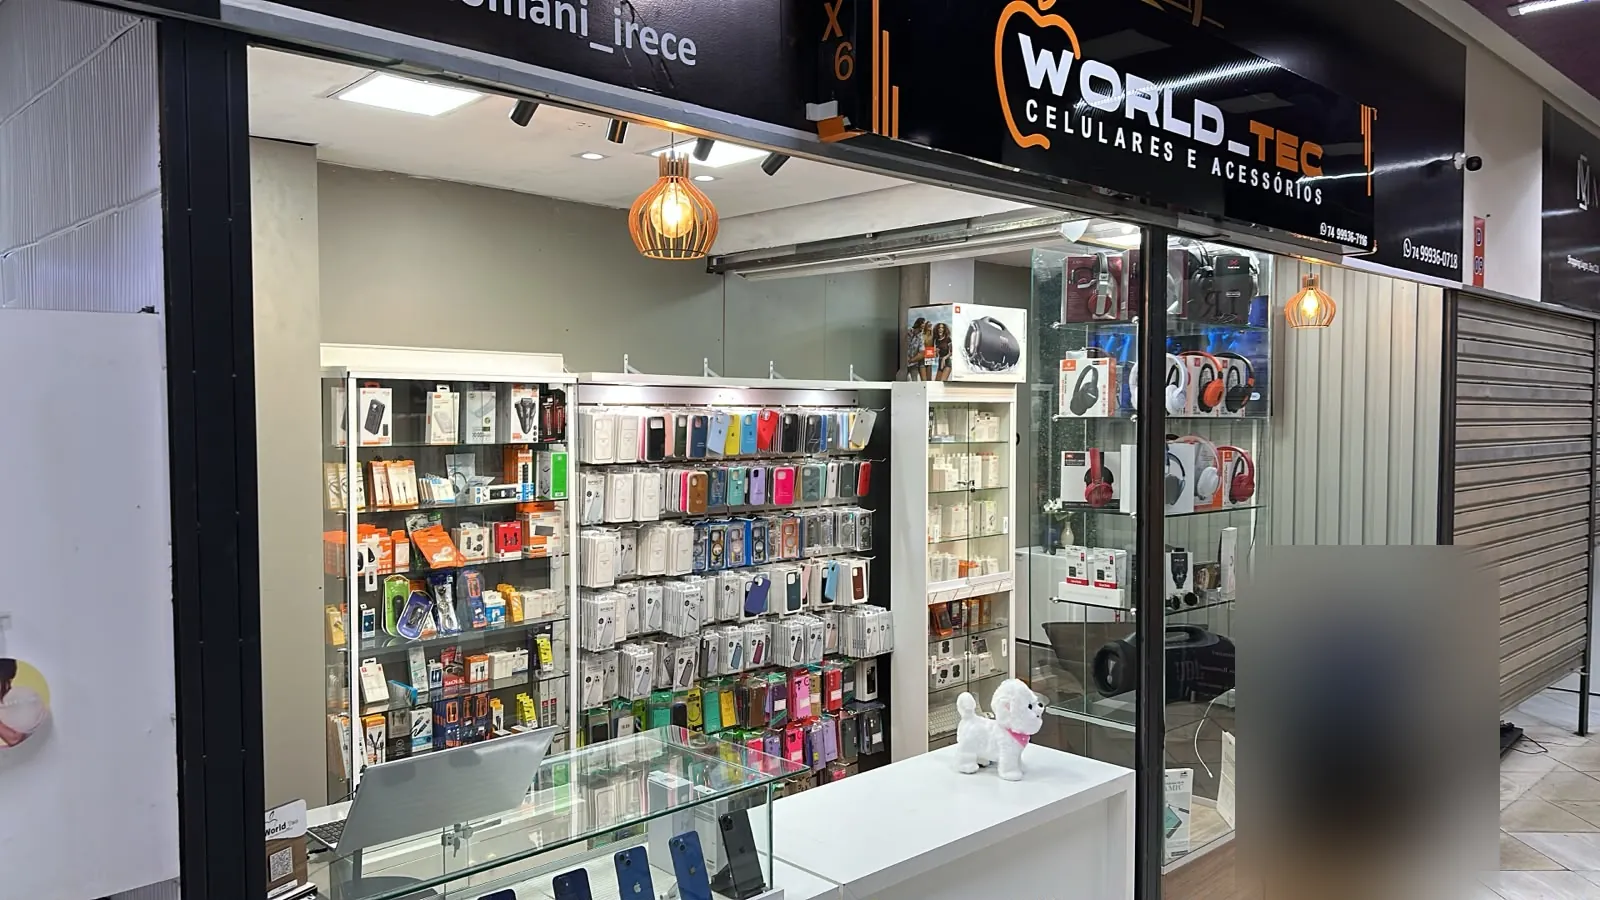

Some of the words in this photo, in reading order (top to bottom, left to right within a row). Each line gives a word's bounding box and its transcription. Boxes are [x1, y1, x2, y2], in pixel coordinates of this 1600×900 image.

[460, 0, 697, 66] mani_irece
[834, 41, 854, 80] 6
[1018, 32, 1323, 177] WORLD_TEC
[1026, 99, 1173, 162] CELULARES
[1187, 148, 1196, 168] E
[1211, 157, 1323, 205] ACESSÓRIOS
[1327, 225, 1335, 238] 74
[1412, 246, 1420, 260] 74
[1420, 244, 1459, 269] 99936-0718
